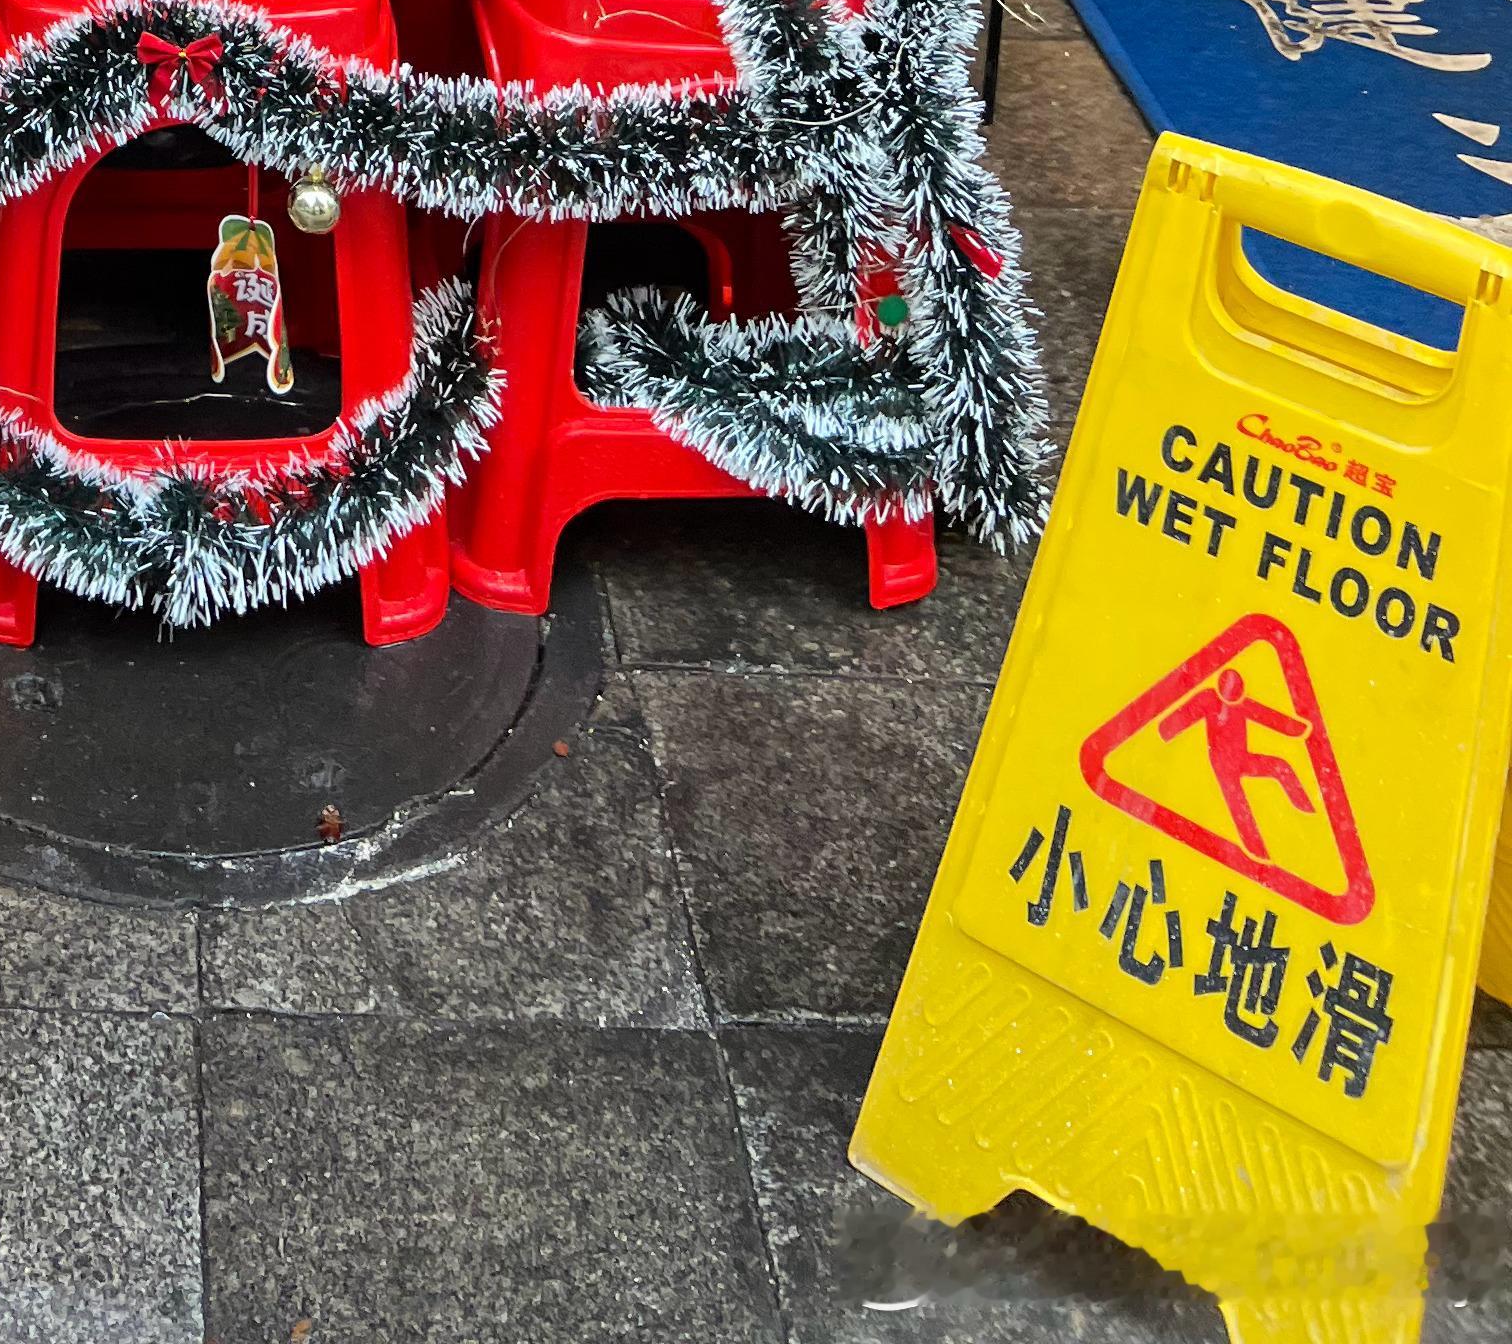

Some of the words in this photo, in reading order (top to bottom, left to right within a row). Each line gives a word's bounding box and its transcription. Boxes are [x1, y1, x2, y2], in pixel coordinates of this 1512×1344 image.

[1115, 467, 1238, 558] WET
[1256, 531, 1462, 664] FLOOR
[1161, 423, 1441, 581] CAUTION
[1008, 804, 1394, 1100] 小心地滑
